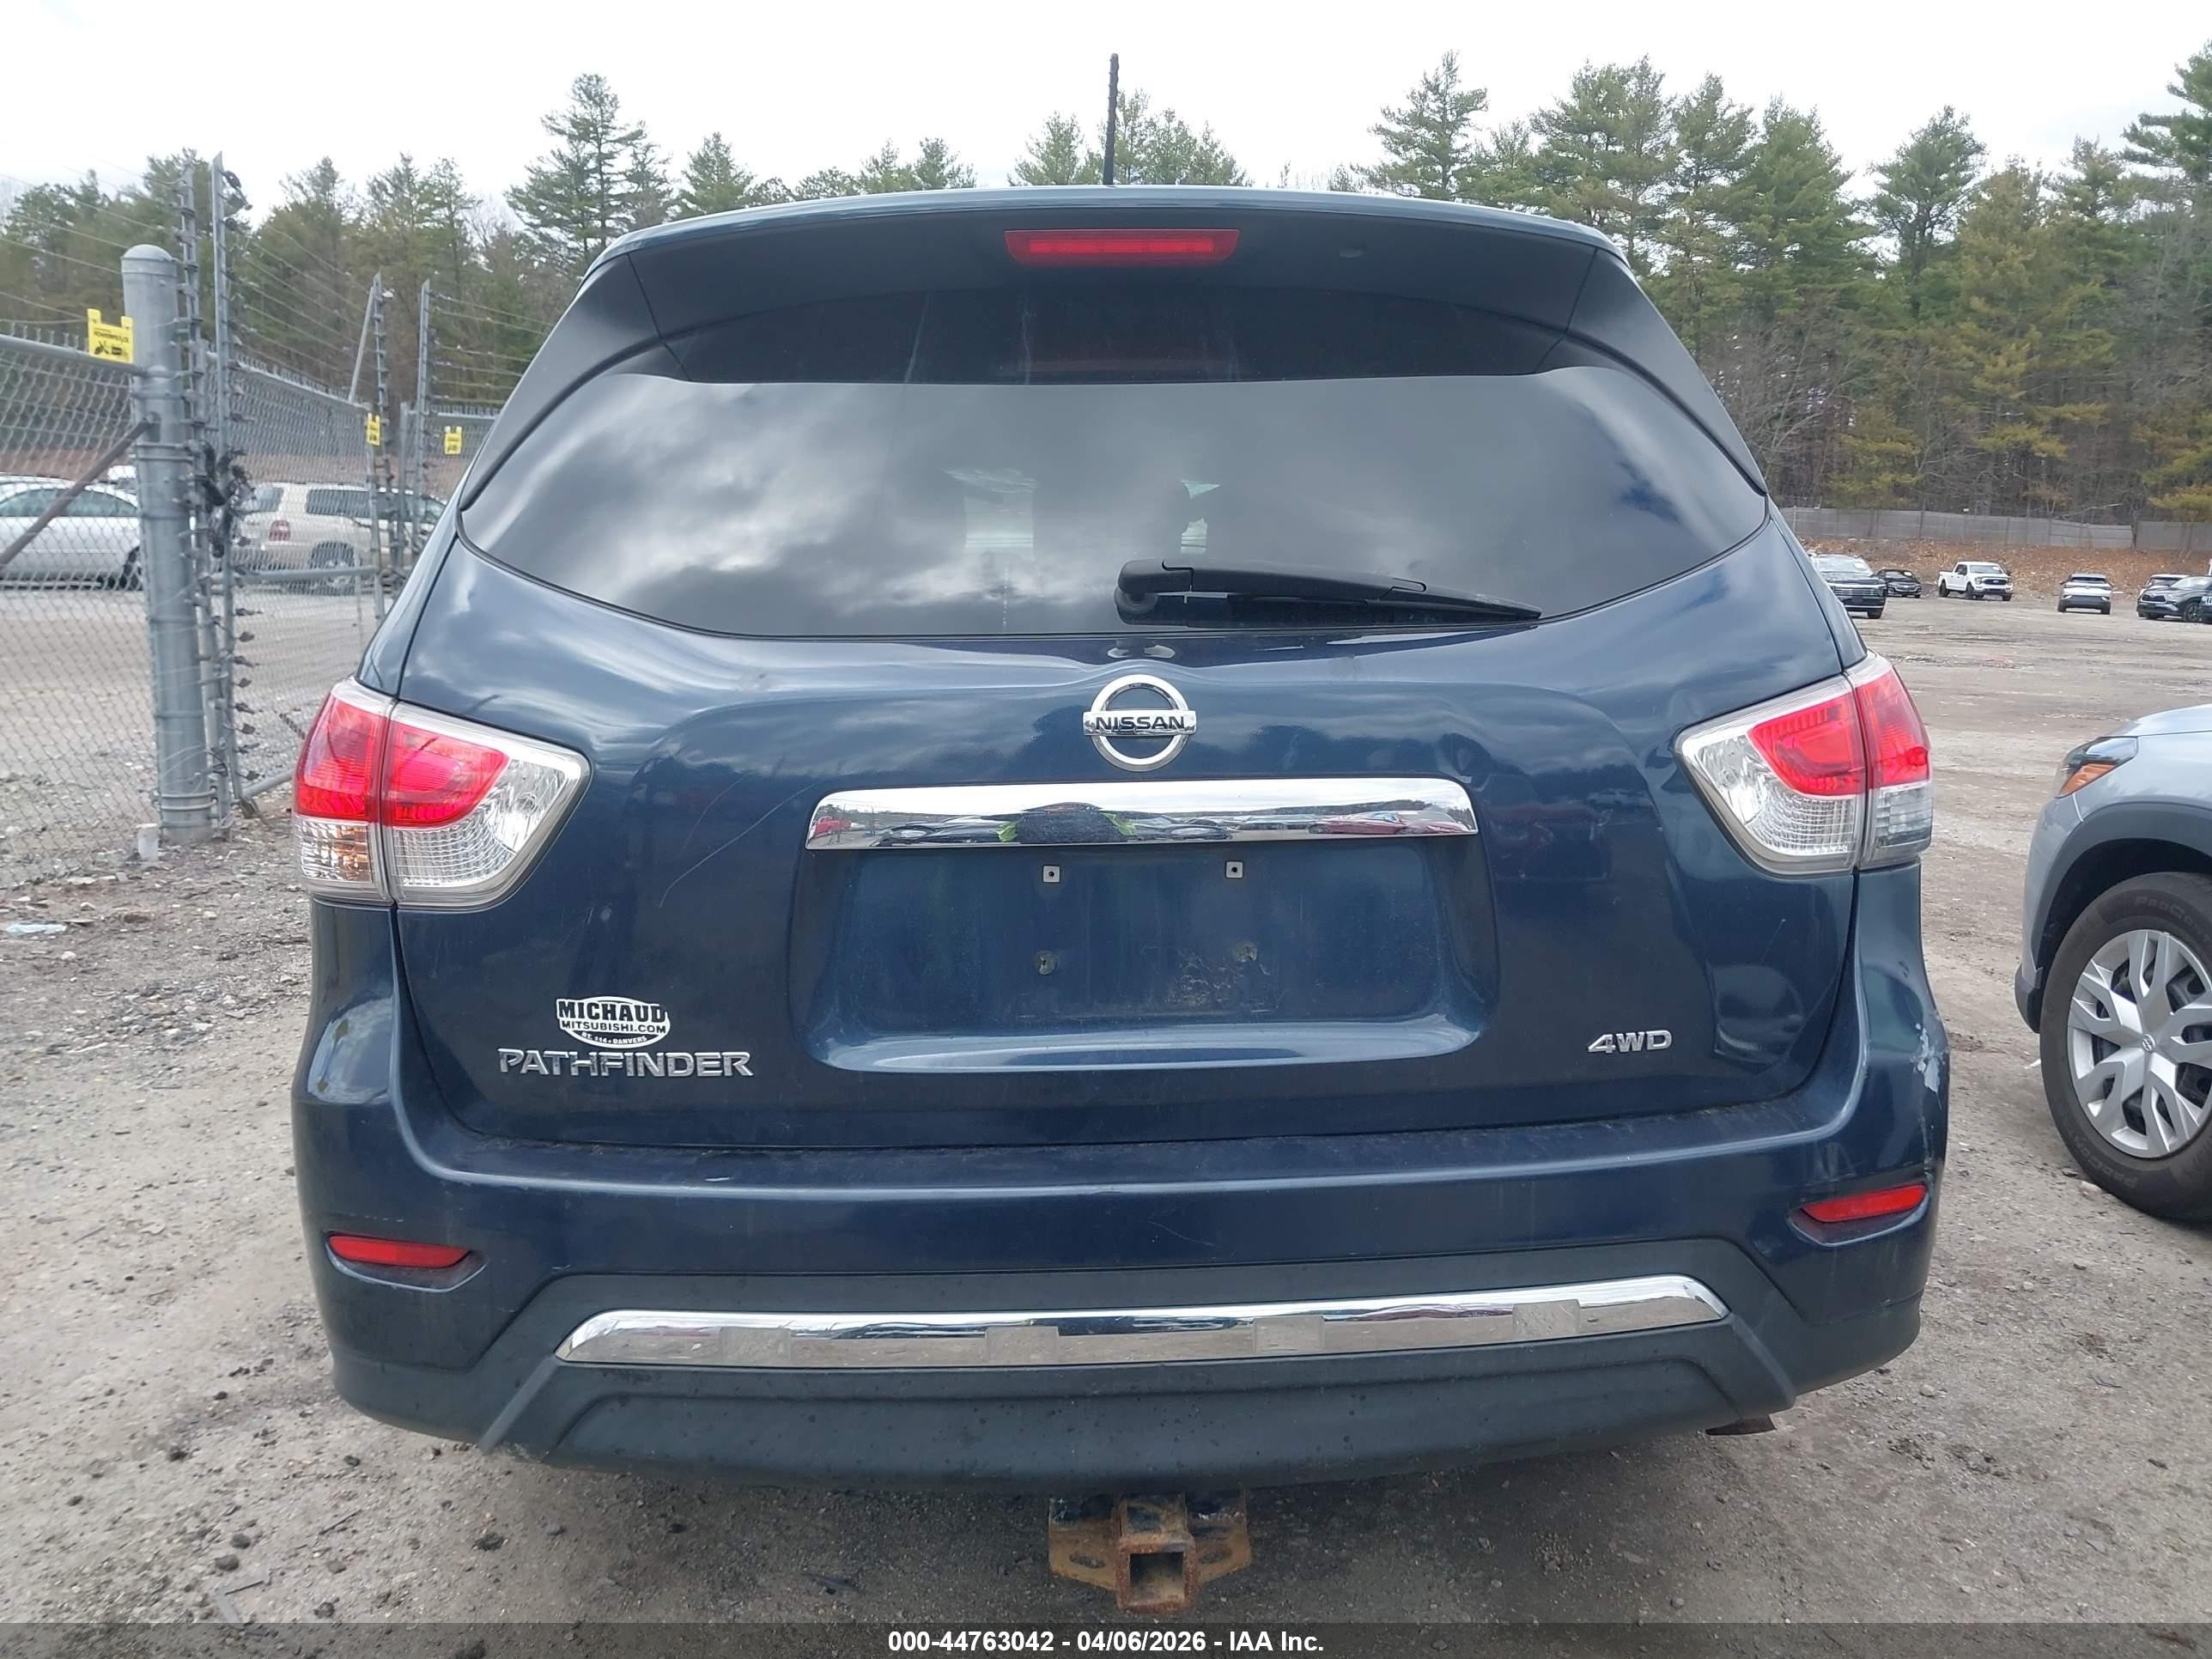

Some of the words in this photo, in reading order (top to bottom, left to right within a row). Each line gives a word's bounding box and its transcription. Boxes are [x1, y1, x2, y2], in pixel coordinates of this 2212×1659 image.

[1095, 715, 1186, 731] NISSAN
[557, 1000, 666, 1024] MICHAUD
[561, 1020, 667, 1035] MITSUBISHI.COM
[612, 1036, 647, 1045] DANVERS
[1587, 1030, 1673, 1054] 4WD
[496, 1048, 755, 1078] PATHFINDER
